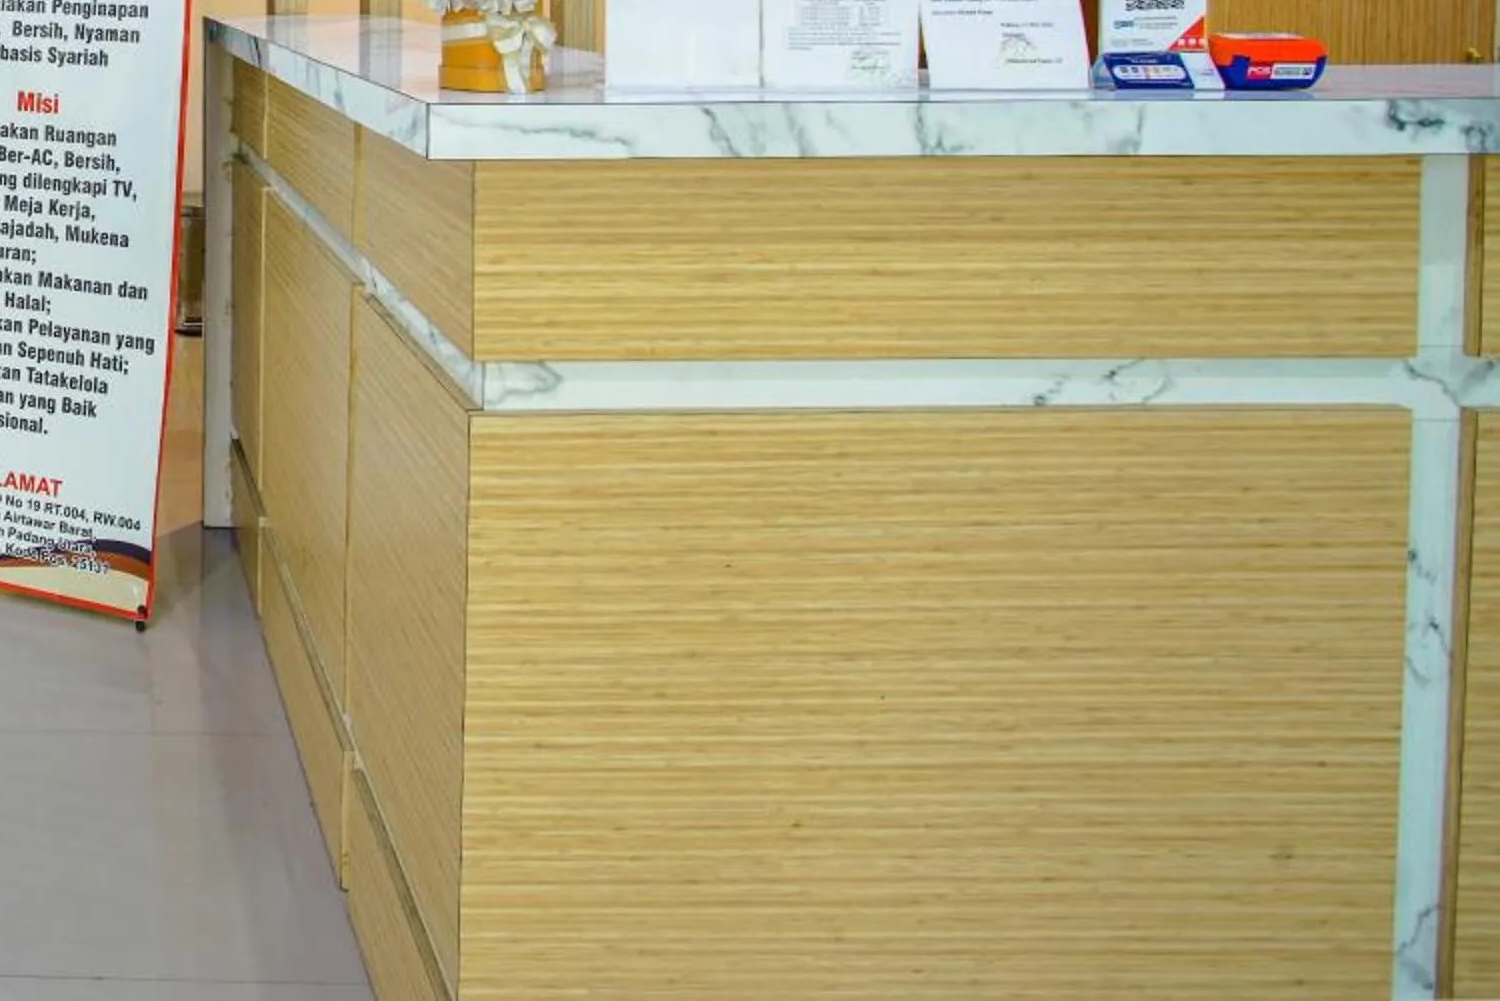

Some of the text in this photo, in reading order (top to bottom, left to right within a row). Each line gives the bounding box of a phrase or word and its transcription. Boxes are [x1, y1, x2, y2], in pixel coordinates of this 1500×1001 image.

[12, 21, 68, 41] Bersih,
[74, 25, 140, 44] Nyaman
[47, 48, 109, 67] Syariah
[17, 90, 59, 114] Misi
[44, 125, 117, 147] Ruangan
[64, 153, 121, 175] Bersih,
[23, 173, 108, 199] dilengkapi
[112, 180, 137, 201] TV,
[3, 195, 43, 215] Meja
[49, 199, 96, 221] Kerja,
[64, 225, 130, 248] Mukena
[38, 272, 113, 296] Makanan
[117, 280, 148, 300] dan
[4, 291, 51, 314] Halal;
[28, 318, 111, 345] Pelayanan
[116, 334, 156, 355] yang
[17, 342, 85, 366] Sepenuh
[90, 354, 129, 375] Hati;
[26, 367, 109, 394] Tatakelola
[19, 393, 56, 413] yang
[62, 396, 97, 418] Baik
[3, 510, 56, 530] Airtawar
[6, 494, 23, 508] No
[28, 498, 41, 511] 19
[94, 510, 141, 531] RW.004
[7, 526, 55, 551] Padang
